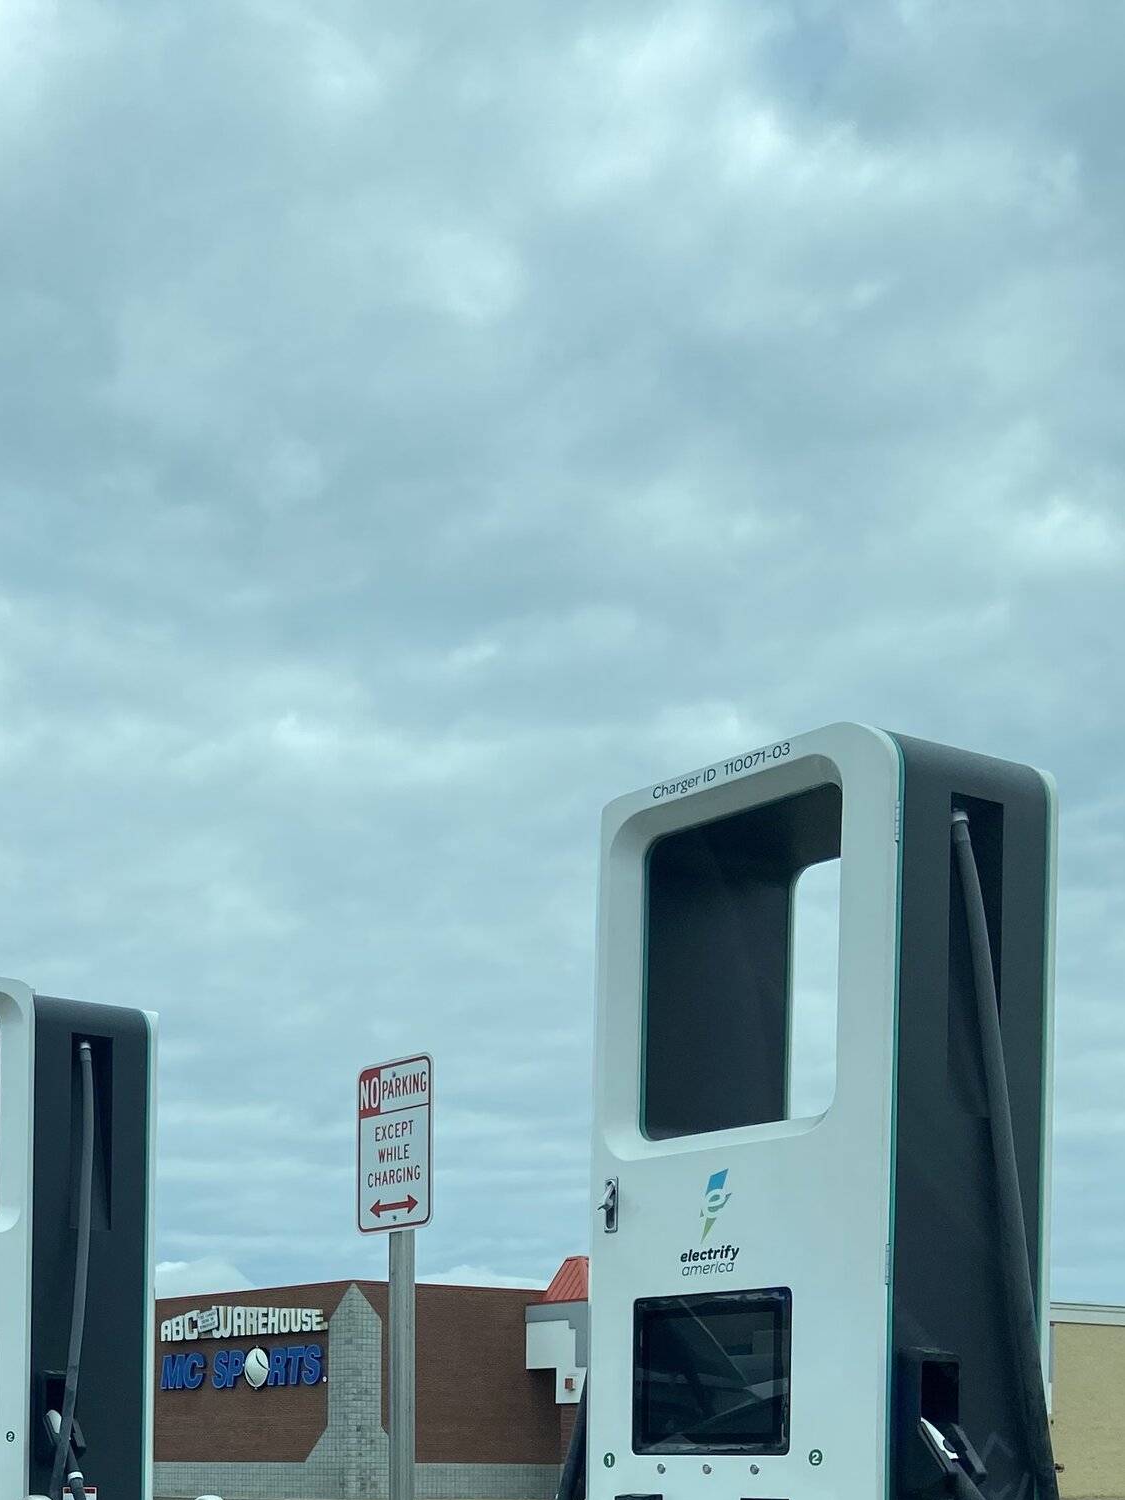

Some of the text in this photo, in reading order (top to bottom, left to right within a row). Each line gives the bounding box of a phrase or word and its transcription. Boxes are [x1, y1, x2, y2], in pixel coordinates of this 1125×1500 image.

[652, 742, 790, 799] Charger ID 110071-03
[360, 1071, 427, 1111] NO PARKING
[375, 1119, 414, 1142] EXCEPT
[378, 1144, 410, 1164] WHILE
[368, 1165, 421, 1188] CHARGING
[680, 1244, 739, 1262] electrify
[681, 1261, 735, 1276] america
[161, 1309, 200, 1342] ABC
[212, 1305, 324, 1339] WAREHOUSE
[160, 1344, 322, 1390] MC SPORTS
